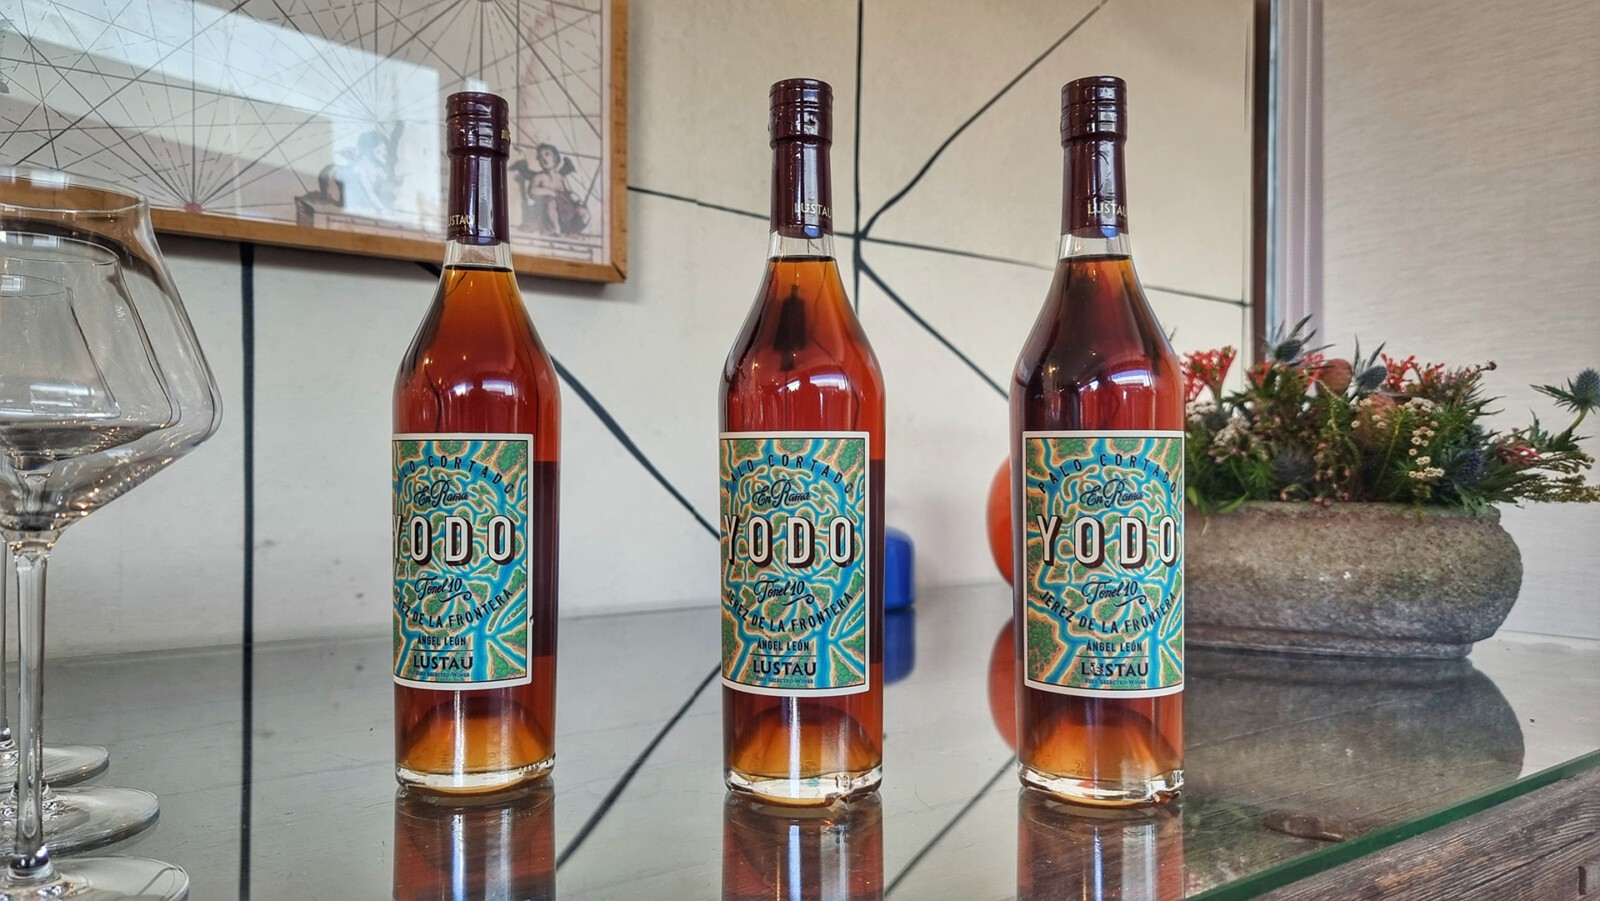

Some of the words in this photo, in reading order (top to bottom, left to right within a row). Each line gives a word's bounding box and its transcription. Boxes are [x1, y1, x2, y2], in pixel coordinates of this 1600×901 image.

[794, 202, 832, 219] LUSTAU
[428, 455, 515, 495] CORTADO
[768, 453, 853, 495] CORTADO
[1039, 458, 1083, 494] PALO
[1100, 453, 1177, 494] CORTADO
[413, 485, 431, 507] En
[430, 479, 470, 508] Rama
[752, 485, 772, 507] En
[770, 478, 811, 509] Rama
[1079, 485, 1103, 508] En
[1102, 478, 1144, 509] Rama
[392, 514, 516, 567] YODO
[724, 513, 856, 569] YODO
[1035, 513, 1177, 569] YODO
[414, 576, 447, 601] Tonel
[446, 577, 463, 593] 10
[753, 579, 790, 604] Tonel
[789, 580, 805, 597] 10
[1081, 578, 1123, 605] Tonel
[1122, 580, 1139, 598] 10
[412, 611, 425, 626] DE
[429, 615, 443, 628] LA
[448, 588, 514, 627] FRONTERA
[726, 589, 750, 622] JEREZ
[751, 613, 765, 629] DE
[770, 619, 786, 632] LA
[791, 593, 854, 632] FRONTERA
[1039, 590, 1075, 623] JEREZ
[1079, 615, 1096, 631] DE
[1101, 619, 1119, 634] LA
[1124, 591, 1177, 633] FRONTERA
[417, 633, 442, 646] ÁNGEL
[757, 637, 784, 651] ÁNGEL
[787, 639, 810, 651] LEÓN
[1086, 639, 1117, 652] ÁNGEL
[1120, 641, 1143, 652] LEÓN
[413, 655, 474, 670] LUSTAU
[753, 660, 817, 676] LUSTAU
[1081, 661, 1149, 677] LUSTAU
